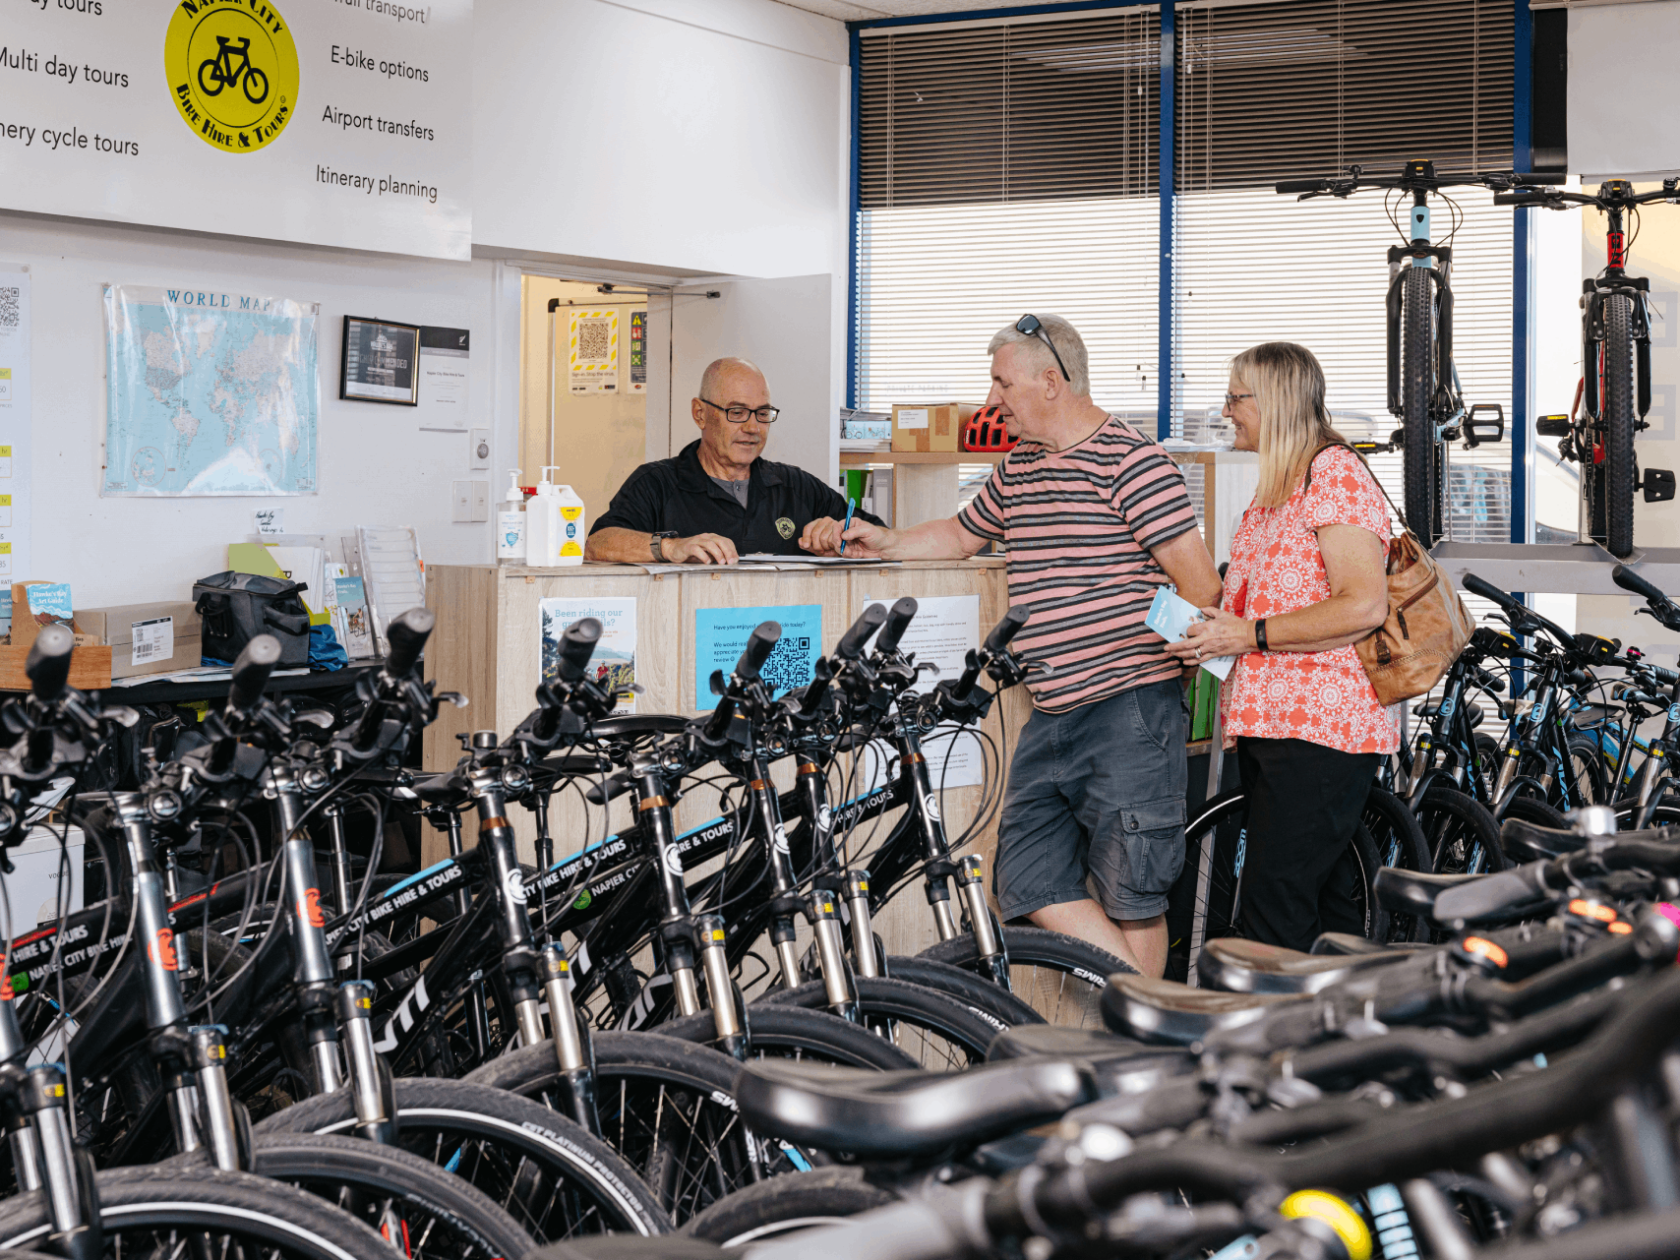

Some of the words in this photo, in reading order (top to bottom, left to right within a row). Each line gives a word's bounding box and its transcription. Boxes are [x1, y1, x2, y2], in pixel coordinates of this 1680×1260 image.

[366, 0, 426, 24] transport
[45, 54, 78, 84] day
[83, 64, 129, 88] tours
[330, 44, 375, 71] E-bike
[379, 60, 429, 82] options
[176, 83, 202, 125] BIKE
[201, 118, 234, 147] HIRE
[237, 131, 251, 148] &
[252, 105, 288, 144] TOURS
[322, 105, 373, 131] Airport
[377, 116, 435, 141] transfers
[42, 126, 89, 150] cycle
[94, 133, 140, 156] tours
[316, 164, 375, 195] Itinerary
[379, 174, 438, 204] planning
[166, 289, 231, 308] WORLD
[239, 296, 271, 312] MAP
[555, 609, 577, 617] Been
[579, 608, 605, 618] riding
[790, 621, 807, 629] today?
[678, 838, 693, 854] IRE
[693, 835, 702, 847] &
[700, 821, 734, 842] TOURS
[559, 860, 583, 880] HIRE
[583, 856, 593, 868] &
[592, 839, 627, 862] TOURS
[370, 901, 394, 921] BIKE
[393, 890, 418, 909] HIRE
[417, 884, 428, 896] &
[426, 865, 463, 891] TOURS
[591, 874, 624, 897] NAPIER
[12, 943, 39, 963] HIRE
[39, 940, 50, 953] &
[49, 924, 89, 947] TOURS
[65, 949, 86, 967] CITY
[1071, 967, 1108, 989] RIMS
[542, 1129, 596, 1164] PLATINUM
[592, 1160, 644, 1212] PROTECTOR
